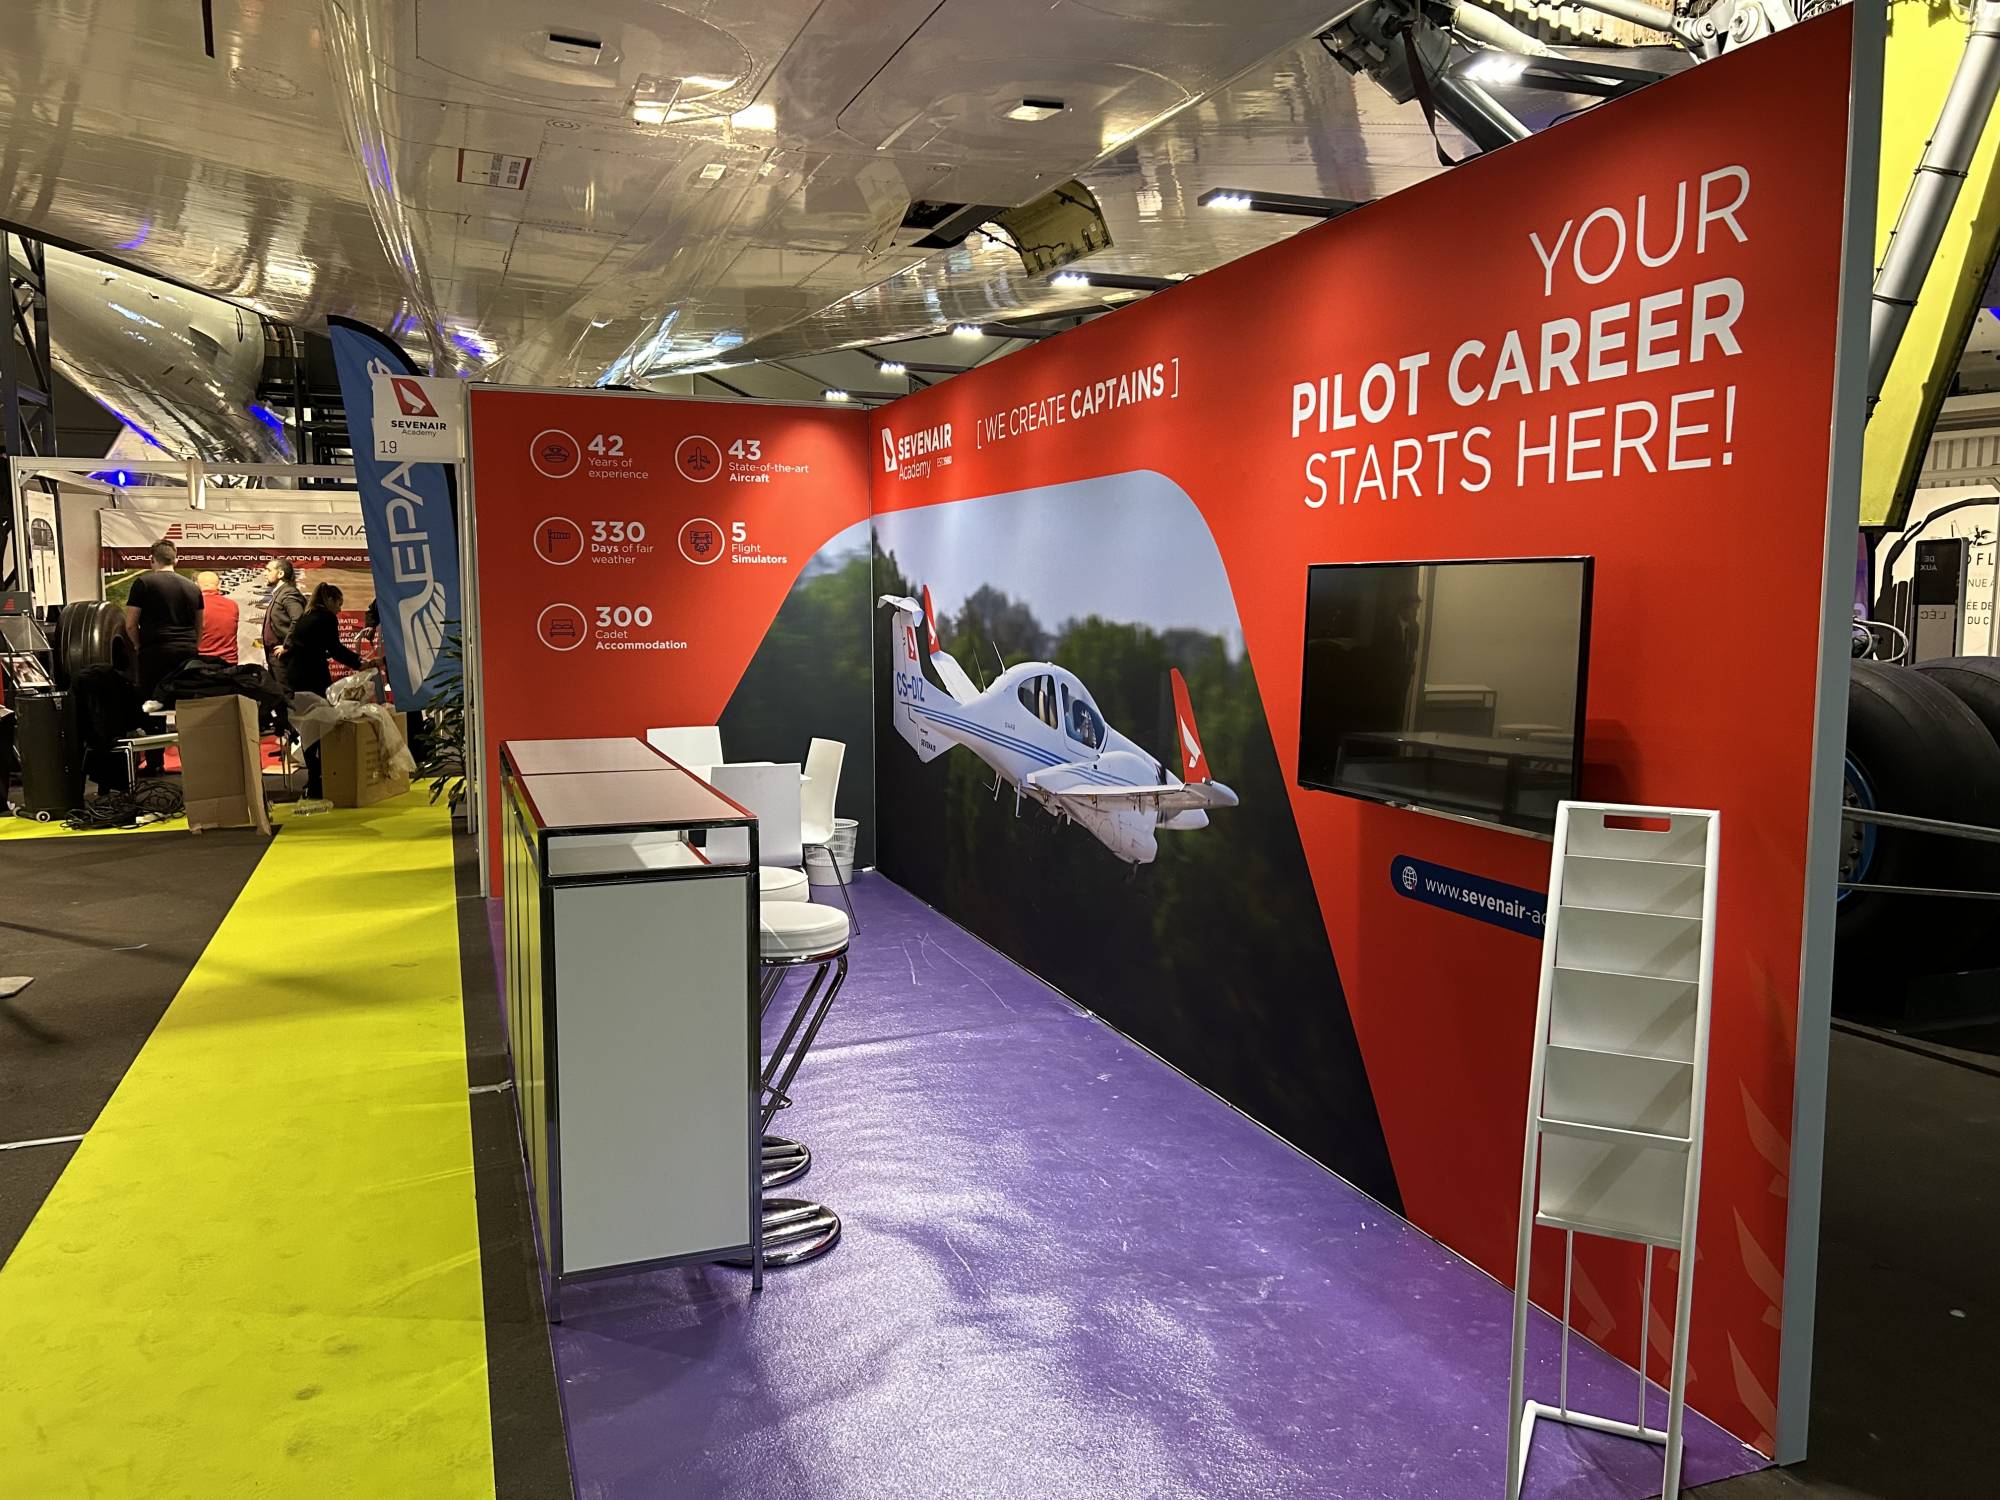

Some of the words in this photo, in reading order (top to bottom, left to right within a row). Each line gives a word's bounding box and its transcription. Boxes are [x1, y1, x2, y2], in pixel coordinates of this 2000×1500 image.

[1529, 165, 1750, 297] YOUR
[1291, 352, 1430, 438] PILOT
[1448, 277, 1744, 407] CAREER
[985, 413, 1006, 443] WE
[1009, 394, 1065, 437] CREATE
[1070, 363, 1164, 420] CAPTAINS
[391, 420, 447, 431] SEVENAIR
[402, 429, 437, 438] Academy
[380, 440, 397, 454] 19
[587, 434, 624, 456] 42
[898, 423, 952, 460] SEVENAIR
[1304, 426, 1491, 509] STARTS
[1517, 385, 1736, 487] HERE!
[728, 439, 761, 460] 43
[588, 457, 617, 468] Years
[620, 457, 633, 467] of
[729, 462, 809, 474] State-of-the-art
[588, 470, 649, 480] experience
[898, 459, 931, 481] Academy
[729, 473, 769, 483] Aircraft
[185, 523, 275, 531] AIRWAYS
[591, 521, 645, 542] 330
[732, 522, 746, 542] 5
[185, 532, 275, 540] AVIATION
[591, 544, 619, 554] Days
[622, 543, 633, 552] of
[635, 543, 654, 552] fair
[731, 543, 761, 554] Flight
[591, 555, 636, 564] weather
[731, 554, 788, 564] Simulators
[1968, 579, 1988, 588] NUE
[595, 606, 653, 627] 300
[595, 630, 628, 639] Cadet
[595, 640, 688, 651] Accommodation
